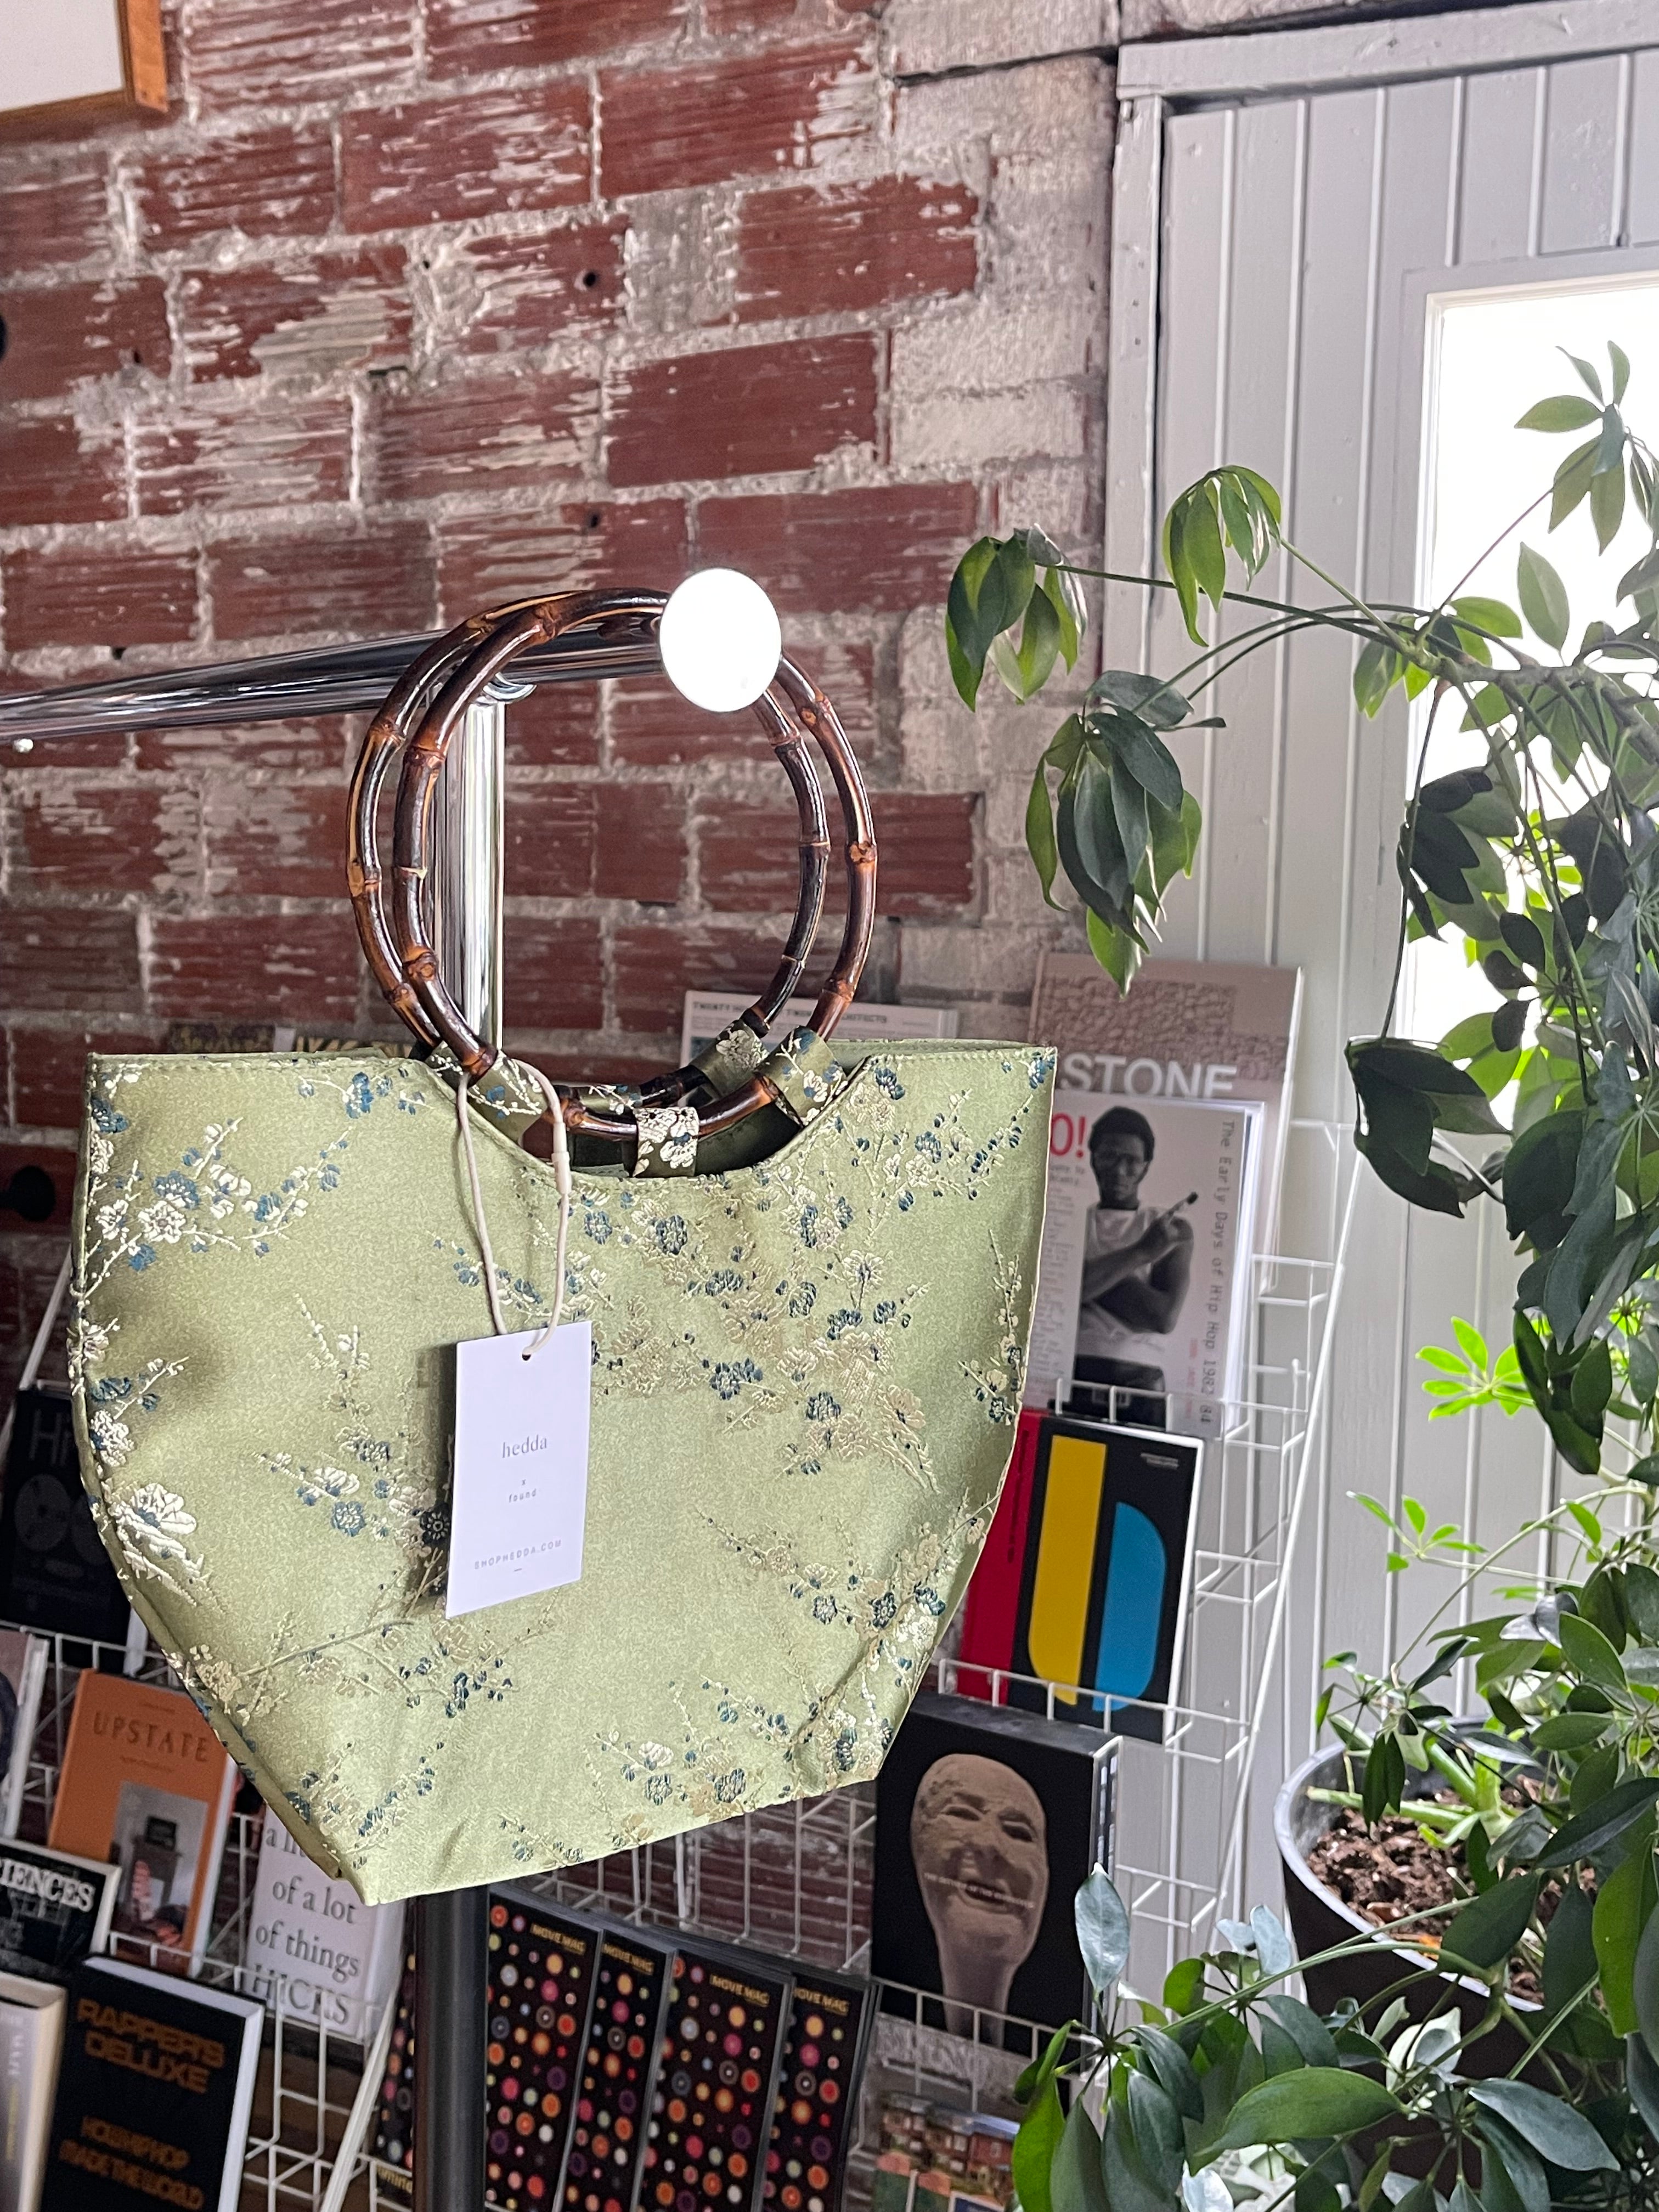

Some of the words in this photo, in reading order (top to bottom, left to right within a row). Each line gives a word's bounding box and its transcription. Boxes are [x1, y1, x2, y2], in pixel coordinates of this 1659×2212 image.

[1221, 1122, 1234, 1147] The
[1213, 1157, 1232, 1205] Early
[1212, 1212, 1228, 1249] Days
[1211, 1257, 1223, 1277] of
[1206, 1285, 1222, 1312] Hip
[1201, 1321, 1220, 1350] Hop
[502, 1434, 548, 1458] hedda
[509, 1488, 537, 1503] found
[474, 1539, 562, 1570] SHOPHEDDA.COM
[93, 1712, 207, 1762] UPSTATE
[0, 1858, 95, 1912] IENCES
[272, 1876, 302, 1905] of
[302, 1891, 315, 1911] a
[323, 1886, 356, 1923] lot
[256, 1920, 284, 1949] of
[286, 1929, 359, 1983] things
